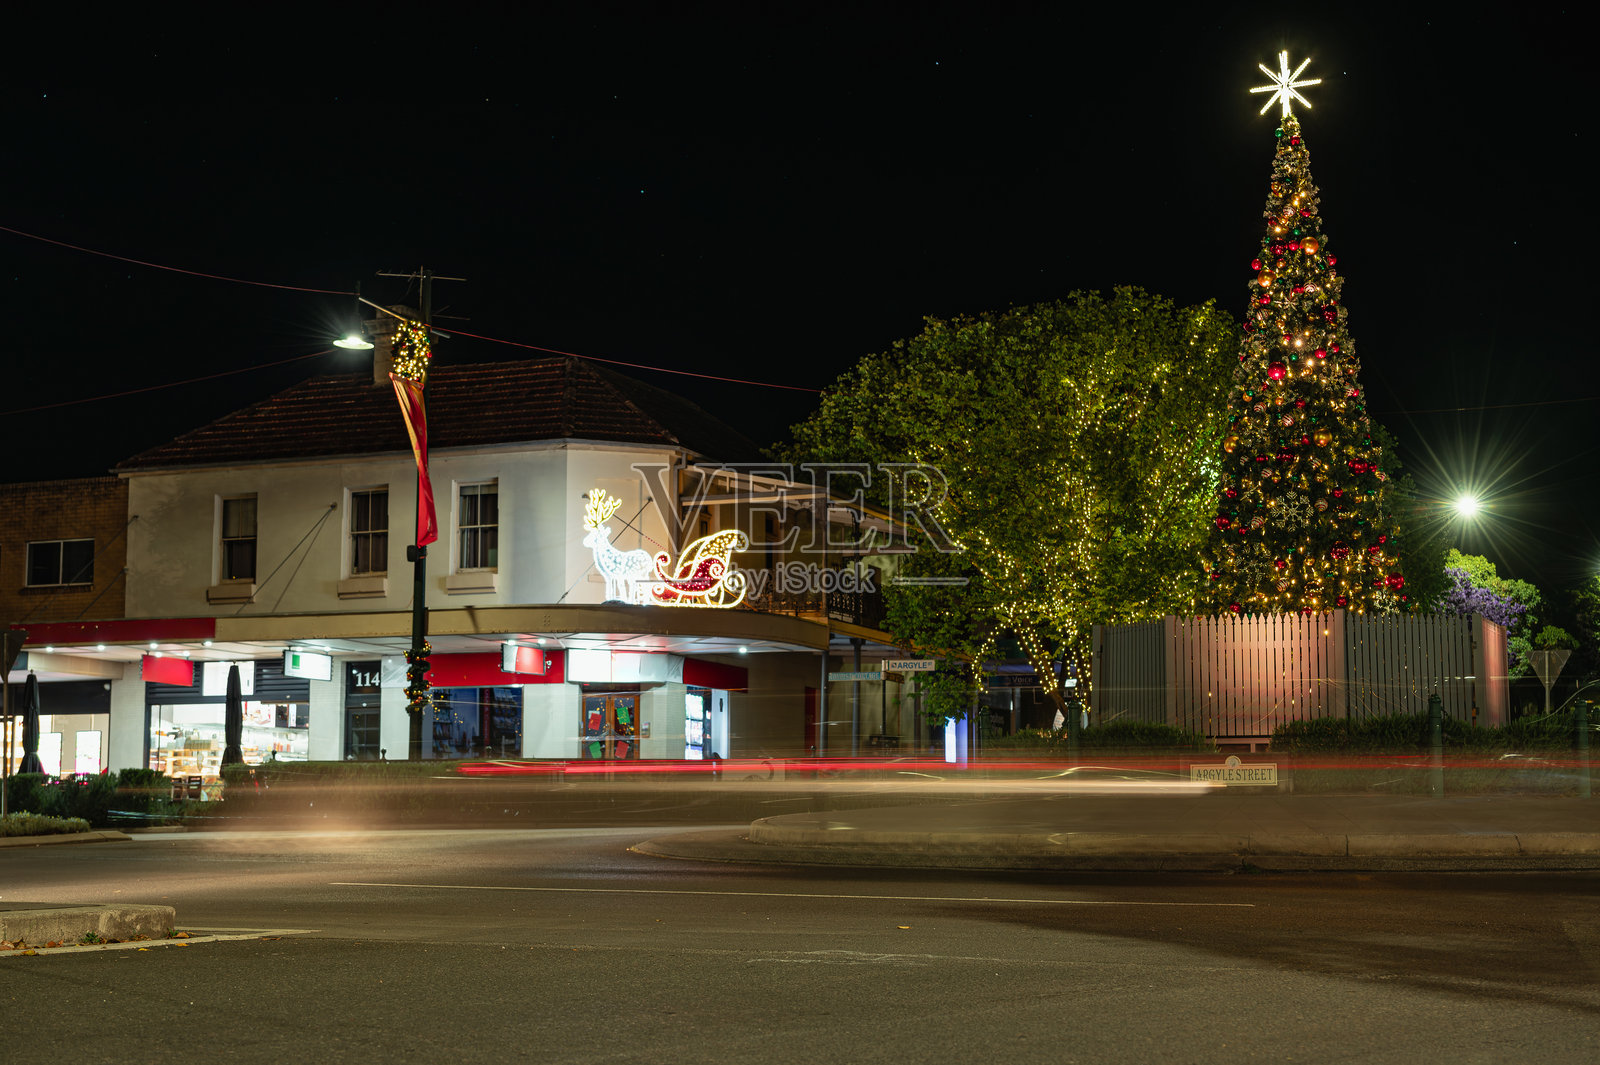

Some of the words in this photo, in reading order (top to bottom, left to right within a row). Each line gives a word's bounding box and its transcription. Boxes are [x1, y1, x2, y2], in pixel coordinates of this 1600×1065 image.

[897, 661, 927, 669] ARGYLE
[355, 671, 381, 687] 114
[1196, 768, 1234, 781] ARGYLE
[1235, 768, 1273, 781] STREET
